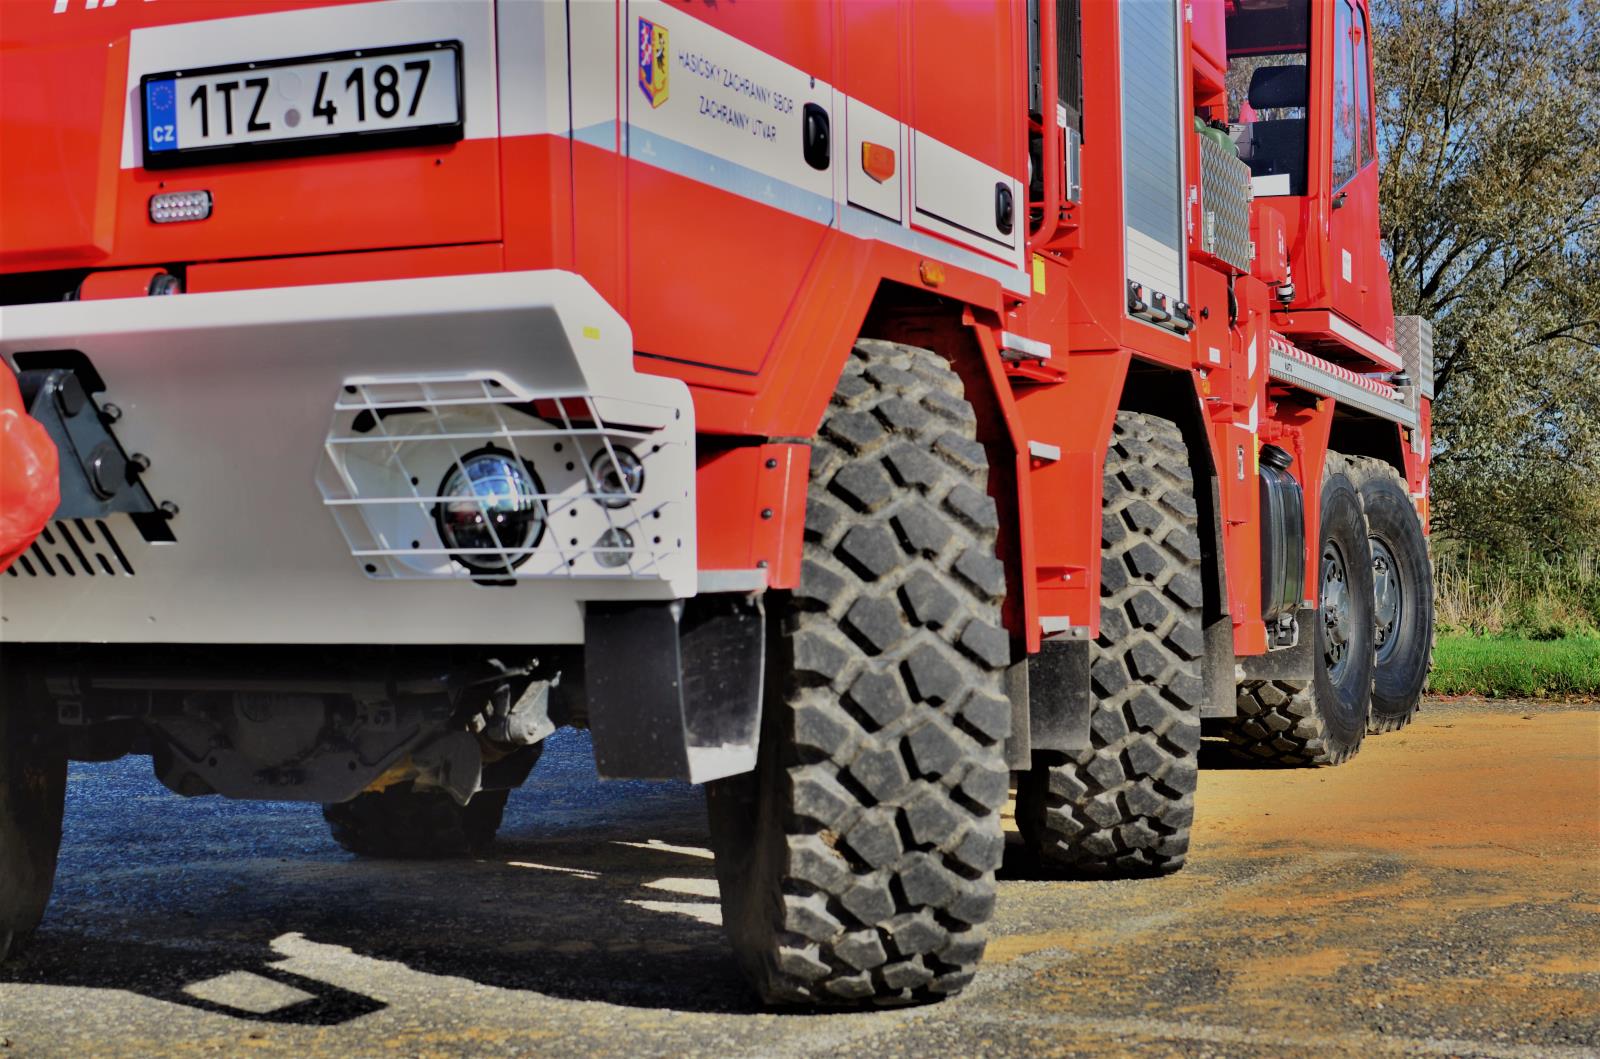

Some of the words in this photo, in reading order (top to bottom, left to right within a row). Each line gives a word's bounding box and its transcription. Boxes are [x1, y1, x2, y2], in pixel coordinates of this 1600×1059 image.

[190, 77, 271, 137] 1TZ
[312, 60, 430, 125] 4187
[773, 92, 794, 114] SBOR
[152, 125, 175, 143] CZ
